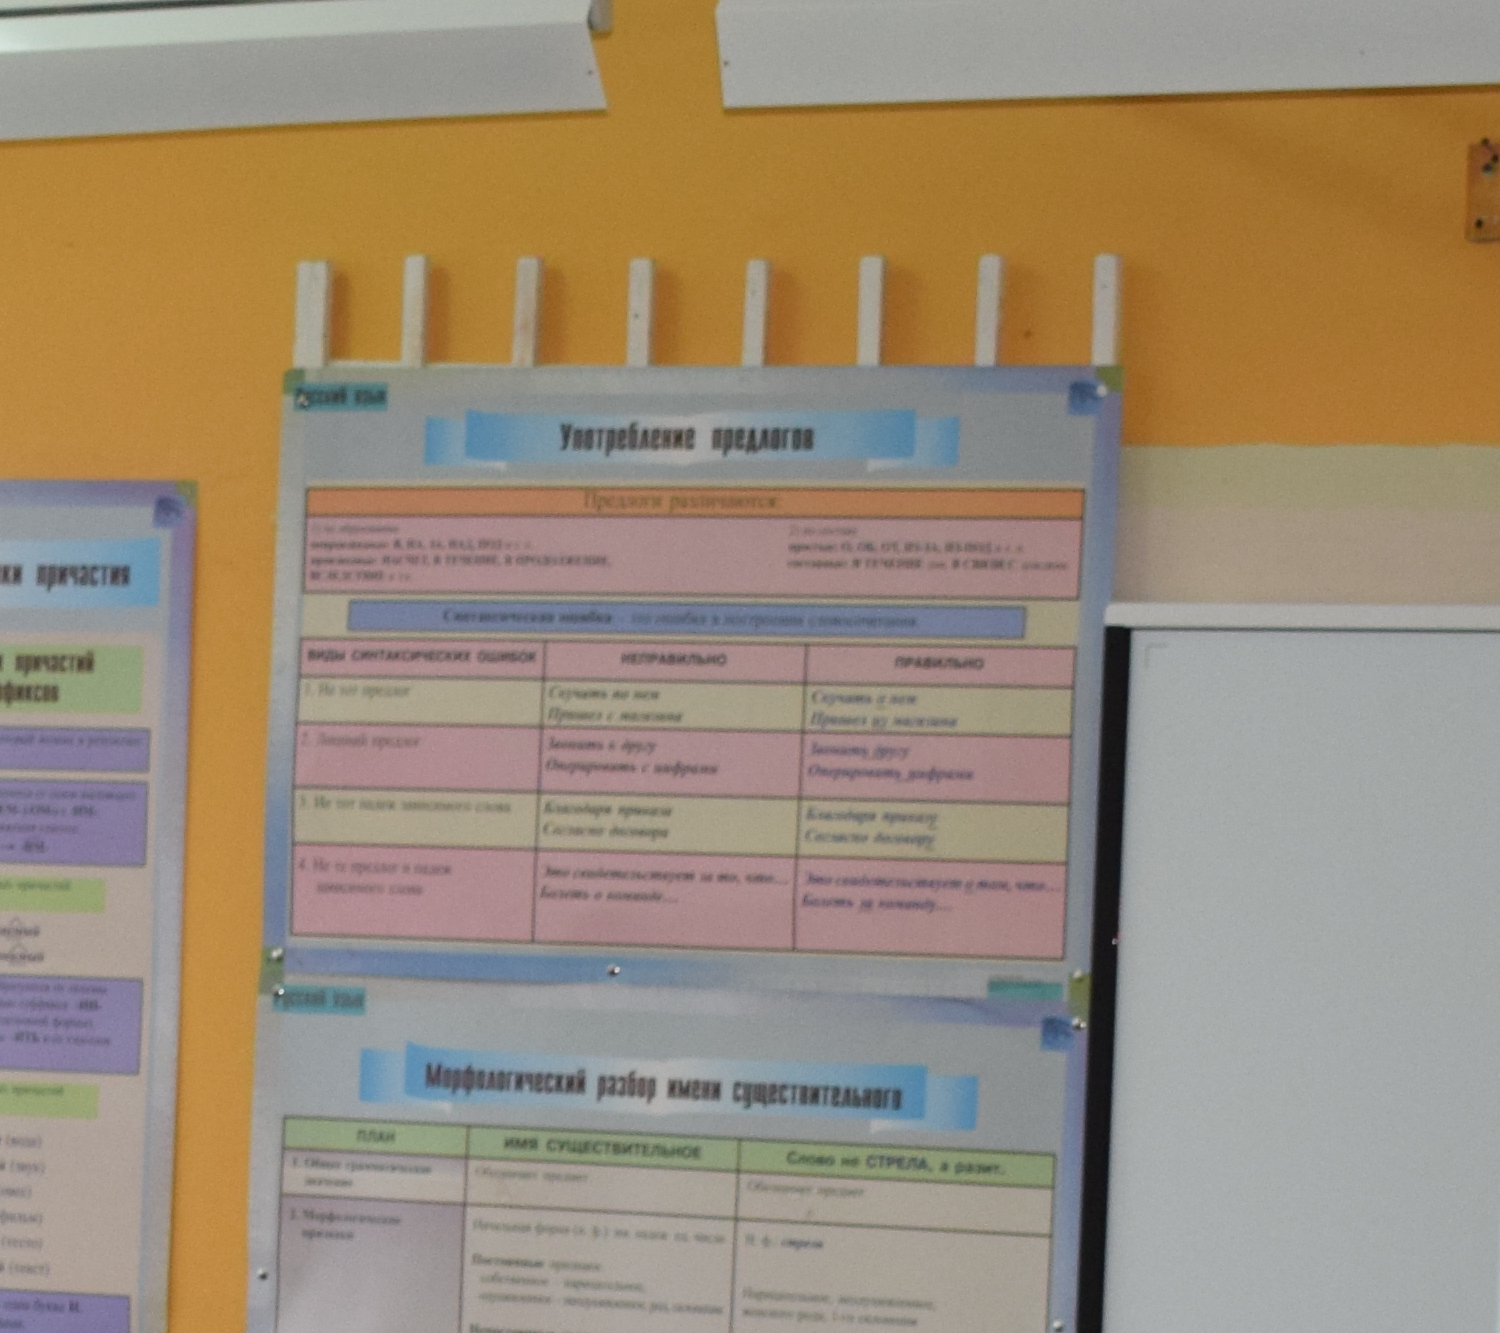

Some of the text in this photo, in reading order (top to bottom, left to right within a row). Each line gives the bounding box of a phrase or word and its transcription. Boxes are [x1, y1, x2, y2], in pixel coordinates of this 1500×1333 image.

[560, 423, 815, 456] Употребление предлогов
[584, 490, 660, 513] Предлоги
[36, 564, 131, 592] причастия
[15, 648, 95, 677] причастий
[307, 649, 537, 665] ВИДЫ СИНТАКСИЧЕСКИХ ОШИБОК
[621, 651, 727, 668] НЕПРАВИЛЬНО
[895, 655, 984, 671] ПРАВИЛЬНО
[425, 1062, 904, 1111] Морфологический разбор имени существительного
[356, 1128, 396, 1144] ПЛАН
[504, 1136, 702, 1161] ИМЯ СУЩЕСТВИТЕЛЬНОЕ
[786, 1150, 836, 1168] Слово
[865, 1155, 933, 1174] СТРЕЛА,
